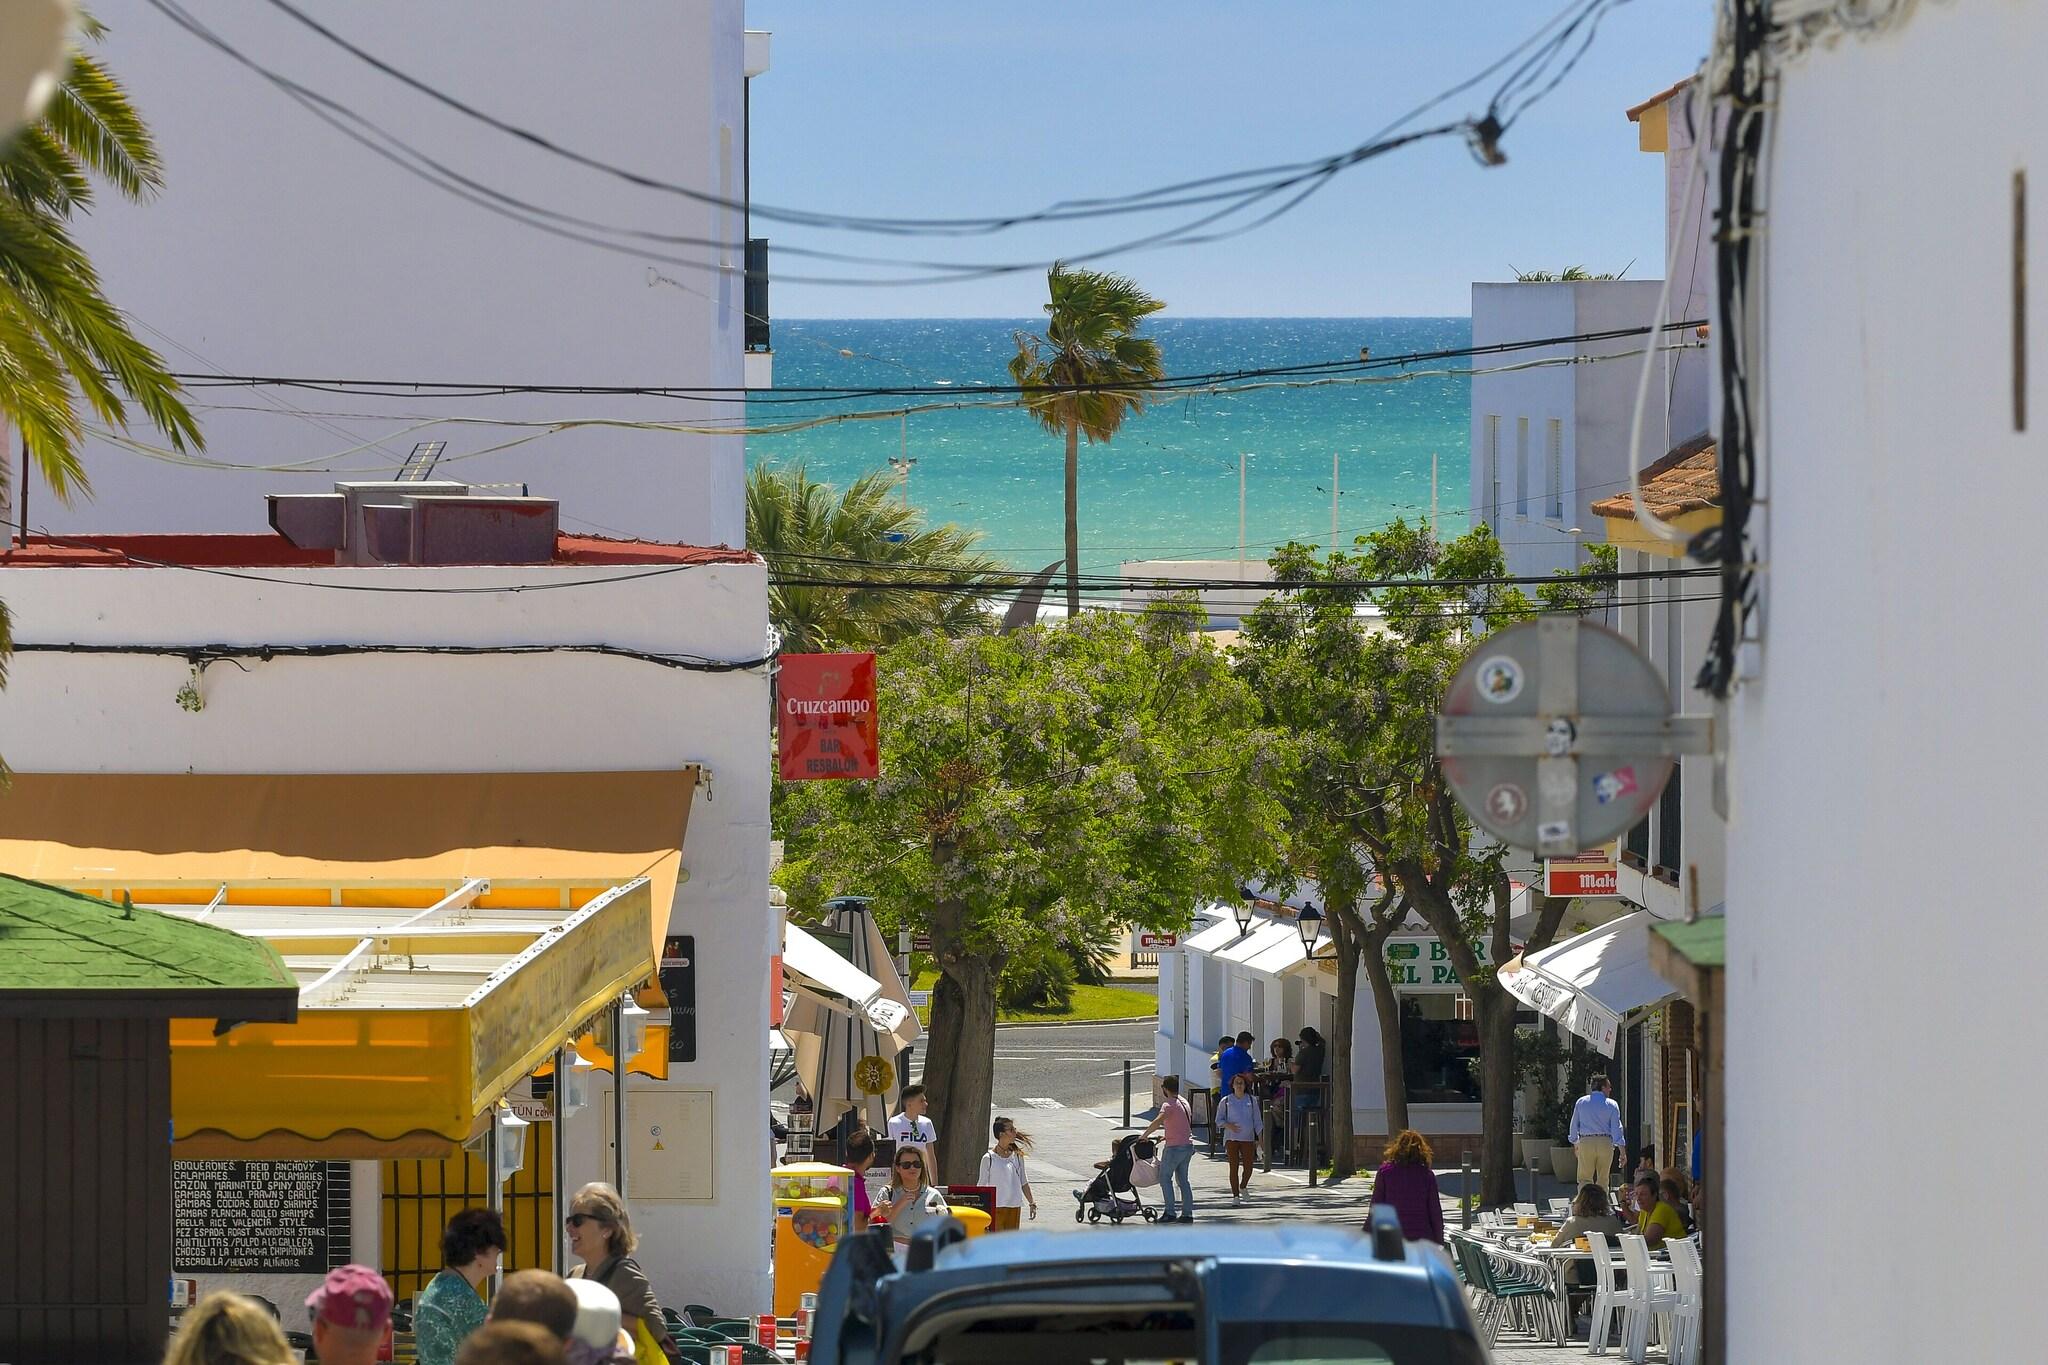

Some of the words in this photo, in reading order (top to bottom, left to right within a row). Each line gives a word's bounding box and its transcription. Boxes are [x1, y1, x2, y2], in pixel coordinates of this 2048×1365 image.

[786, 697, 870, 717] Cruzcampo
[819, 738, 840, 753] BAR
[1579, 873, 1617, 888] Mah
[1429, 942, 1486, 960] BR
[1432, 966, 1461, 984] PA
[511, 1104, 533, 1117] TÚN
[900, 1131, 928, 1143] FILA
[245, 1162, 269, 1171] FREID
[245, 1171, 270, 1180] FREID
[214, 1181, 263, 1190] MARINATED
[267, 1181, 293, 1190] SPINY
[174, 1190, 212, 1200] GAMBAS
[248, 1190, 284, 1200] PRAWNS
[174, 1199, 212, 1209] GAMBAS
[253, 1199, 280, 1209] BOILED
[175, 1209, 208, 1218] GAMBAS
[232, 1217, 272, 1228] VALENCIA
[175, 1227, 192, 1237] PEZ
[254, 1227, 296, 1237] SWORDFISH
[278, 1237, 314, 1248] GALLEGA
[175, 1247, 207, 1257] CHOCOS
[209, 1247, 217, 1257] A
[219, 1247, 230, 1257] LA
